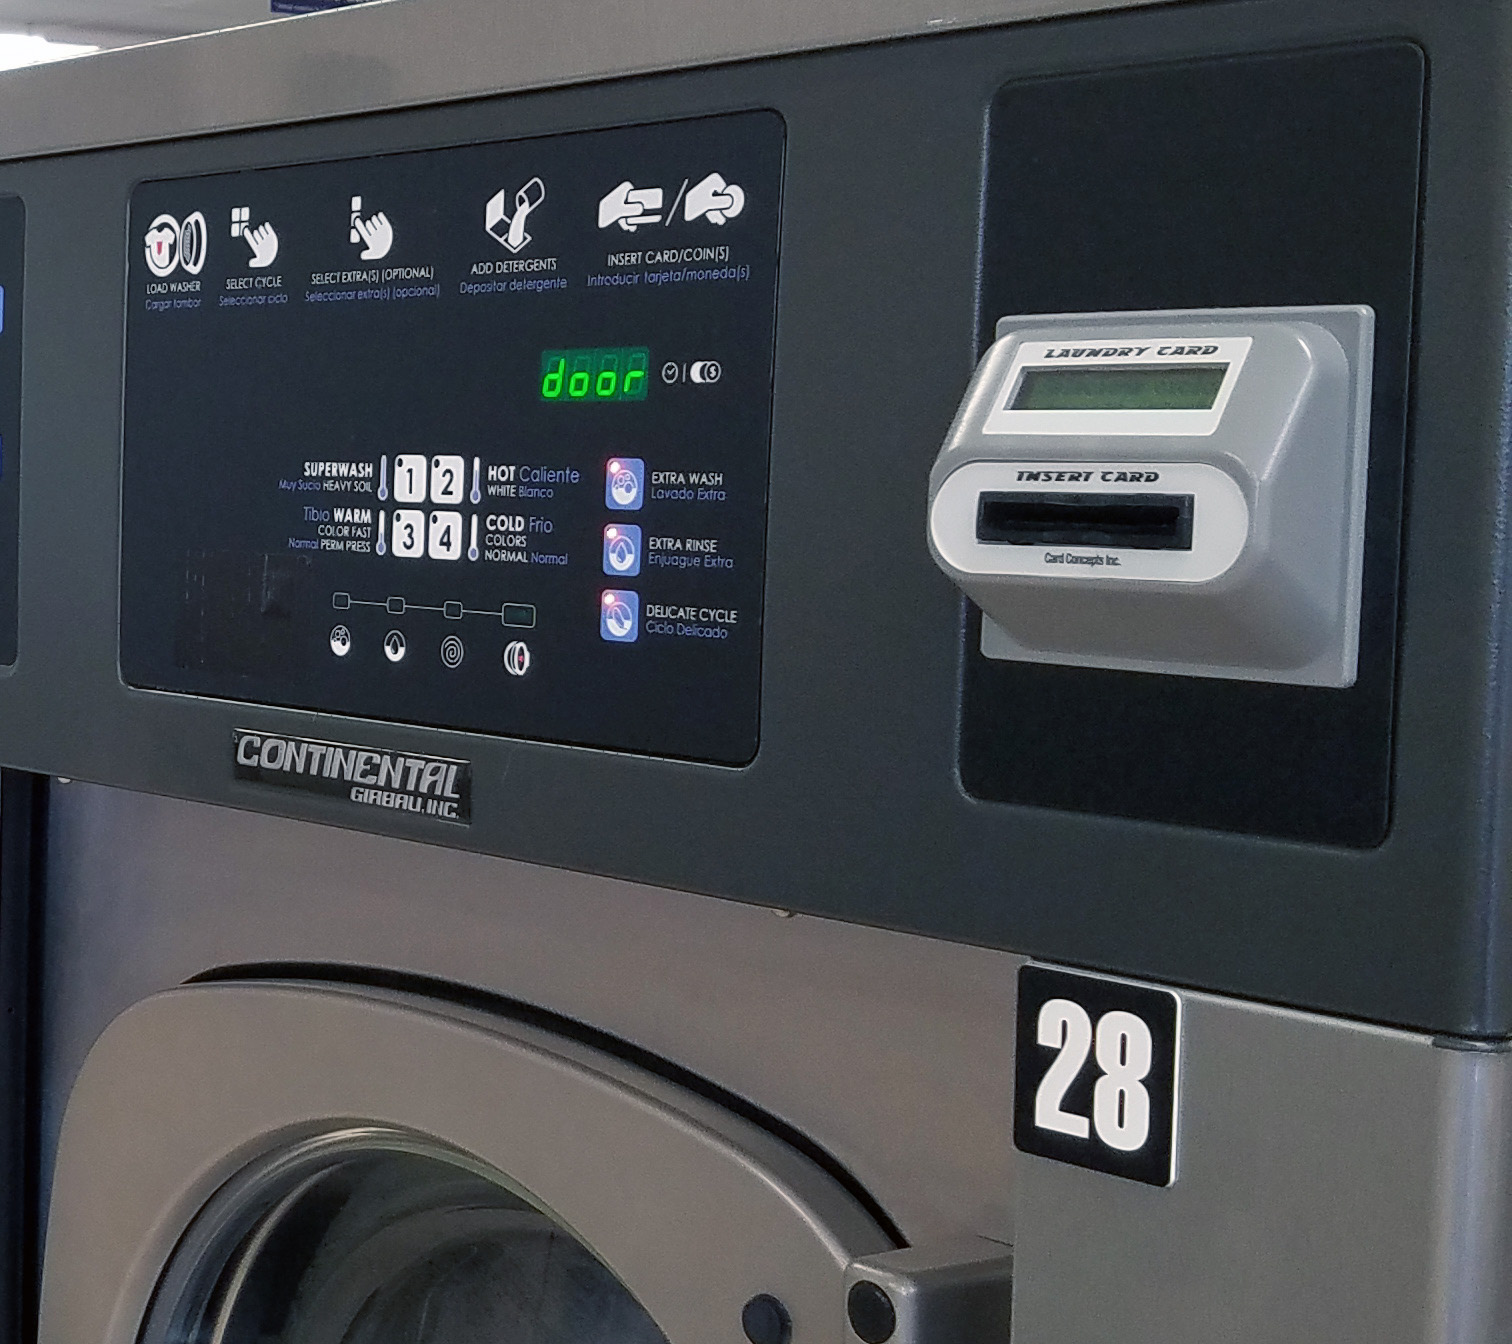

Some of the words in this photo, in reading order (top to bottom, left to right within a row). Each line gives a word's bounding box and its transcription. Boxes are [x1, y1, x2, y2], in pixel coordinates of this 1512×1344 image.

[470, 262, 494, 276] ADD
[495, 258, 557, 274] DETERGENTS
[607, 251, 642, 267] INSERT
[225, 277, 254, 290] SELECT
[255, 276, 283, 289] CYCLE
[311, 272, 340, 285] SELECT
[341, 269, 380, 284] EXTRA(S)
[381, 266, 435, 282] (OPTIONAL)
[587, 272, 641, 287] Introducir
[146, 282, 168, 295] LOAD
[169, 280, 201, 293] WASHER
[509, 277, 568, 292] detergente
[304, 288, 356, 303] Seleccionar
[1043, 346, 1152, 360] LAUNDRY
[1156, 345, 1220, 356] CARD
[541, 358, 645, 398] door
[303, 460, 374, 478] SUPERWASH
[487, 465, 516, 483] HOT
[519, 465, 581, 484] Caliente
[1016, 470, 1094, 483] INSERT
[1100, 471, 1160, 483] CARD
[323, 479, 352, 492] HEAVY
[353, 480, 373, 493] SOIL
[405, 467, 414, 495] 1
[440, 468, 455, 496] 2
[651, 471, 686, 485] EXTRA
[688, 472, 724, 486] WASH
[487, 485, 517, 498] WHITE
[518, 485, 554, 498] Blanco
[650, 486, 694, 500] Lavado
[696, 487, 727, 501] Extra
[303, 506, 330, 522] Tibio
[333, 507, 372, 524] WARM
[317, 524, 350, 537] COLOR
[351, 525, 372, 538] FAST
[485, 514, 525, 533] COLD
[528, 516, 554, 534] Frio
[402, 522, 415, 550] 3
[439, 524, 453, 552] 4
[485, 533, 527, 548] COLORS
[288, 537, 319, 550] Normal
[320, 538, 345, 552] PERM
[345, 540, 371, 553] PRESS
[649, 537, 683, 551] EXTRA
[685, 538, 718, 553] RINSE
[484, 549, 529, 564] NORMAL
[530, 550, 569, 566] Normal
[704, 554, 734, 569] Extra
[1044, 552, 1065, 564] Card
[1065, 553, 1104, 567] Concepts
[646, 605, 697, 621] DELICATE
[699, 608, 738, 624] CYCLE
[645, 620, 675, 634] Ciclo
[676, 622, 728, 639] Delicado
[236, 735, 461, 799] CONTINENTAL
[1035, 998, 1152, 1151] 28
